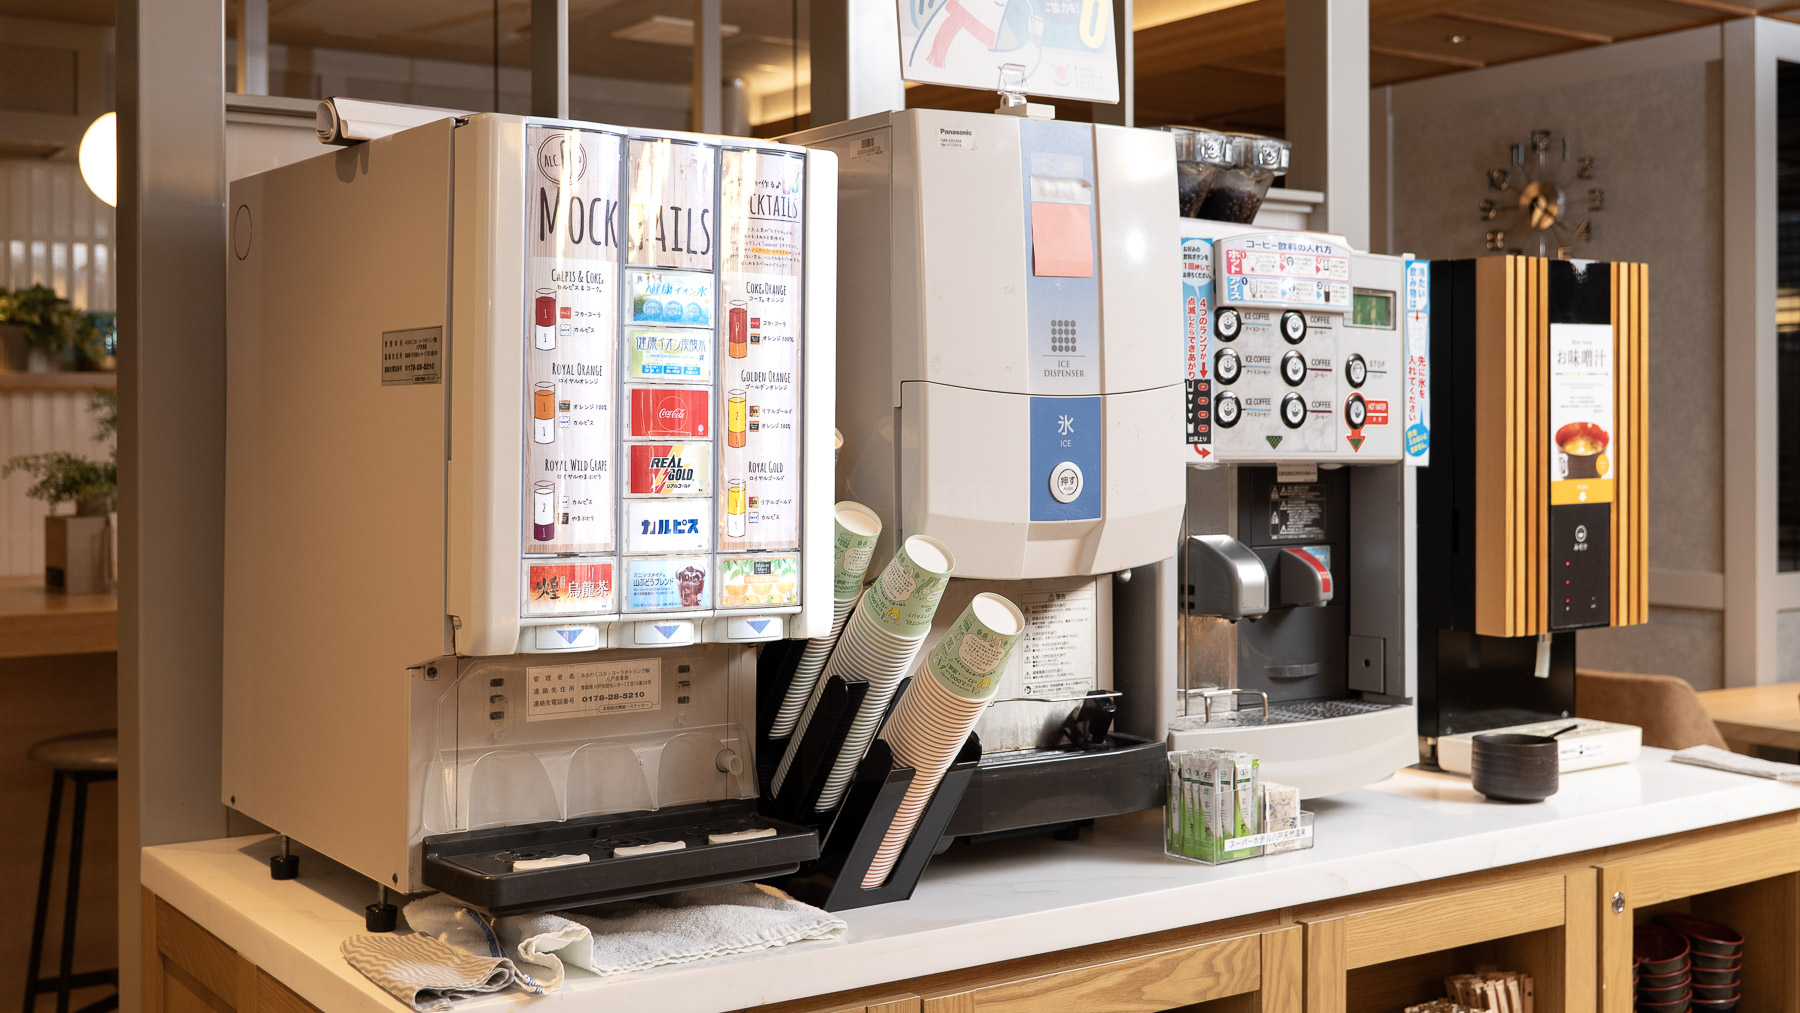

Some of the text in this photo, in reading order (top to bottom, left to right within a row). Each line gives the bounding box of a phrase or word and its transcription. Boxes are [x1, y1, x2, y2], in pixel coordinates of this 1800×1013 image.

[940, 128, 972, 136] Panasonic
[1574, 219, 1592, 242] 4
[1246, 240, 1332, 254] コーヒー飲料の入れ方
[1184, 262, 1210, 271] 1回押して
[1228, 250, 1240, 274] ホット
[578, 271, 584, 283] &
[1229, 277, 1242, 300] アイス
[1252, 312, 1270, 320] COFFEE
[1310, 316, 1330, 324] COFFEE
[1199, 299, 1208, 360] 4つのランプが
[635, 336, 707, 353] 健康イオン炭酸水
[1187, 297, 1196, 380] 点滅したらできあがり
[1057, 360, 1070, 368] ICE
[1311, 359, 1331, 367] COFFEE
[1370, 360, 1385, 368] STOP
[1557, 348, 1606, 367] お味噌汁
[552, 363, 603, 377] ROYAL ORANGE
[741, 370, 791, 383] GOLDEN ORANGE
[1043, 369, 1085, 377] DISPENSER
[1418, 356, 1426, 399] 先に氷を
[1408, 355, 1417, 421] 入れてください
[1057, 414, 1075, 435] 氷
[571, 459, 588, 472] WILD
[590, 459, 607, 472] GRAPE
[651, 454, 683, 468] REAL
[748, 461, 784, 473] ROYAL GOLD
[668, 469, 694, 481] GOLD
[1060, 476, 1075, 486] 押す
[641, 519, 699, 535] カルピス
[567, 580, 610, 598] 烏龍茶
[633, 578, 674, 587] 山ぶどうブレンド
[581, 691, 645, 703] 0178-28-5210
